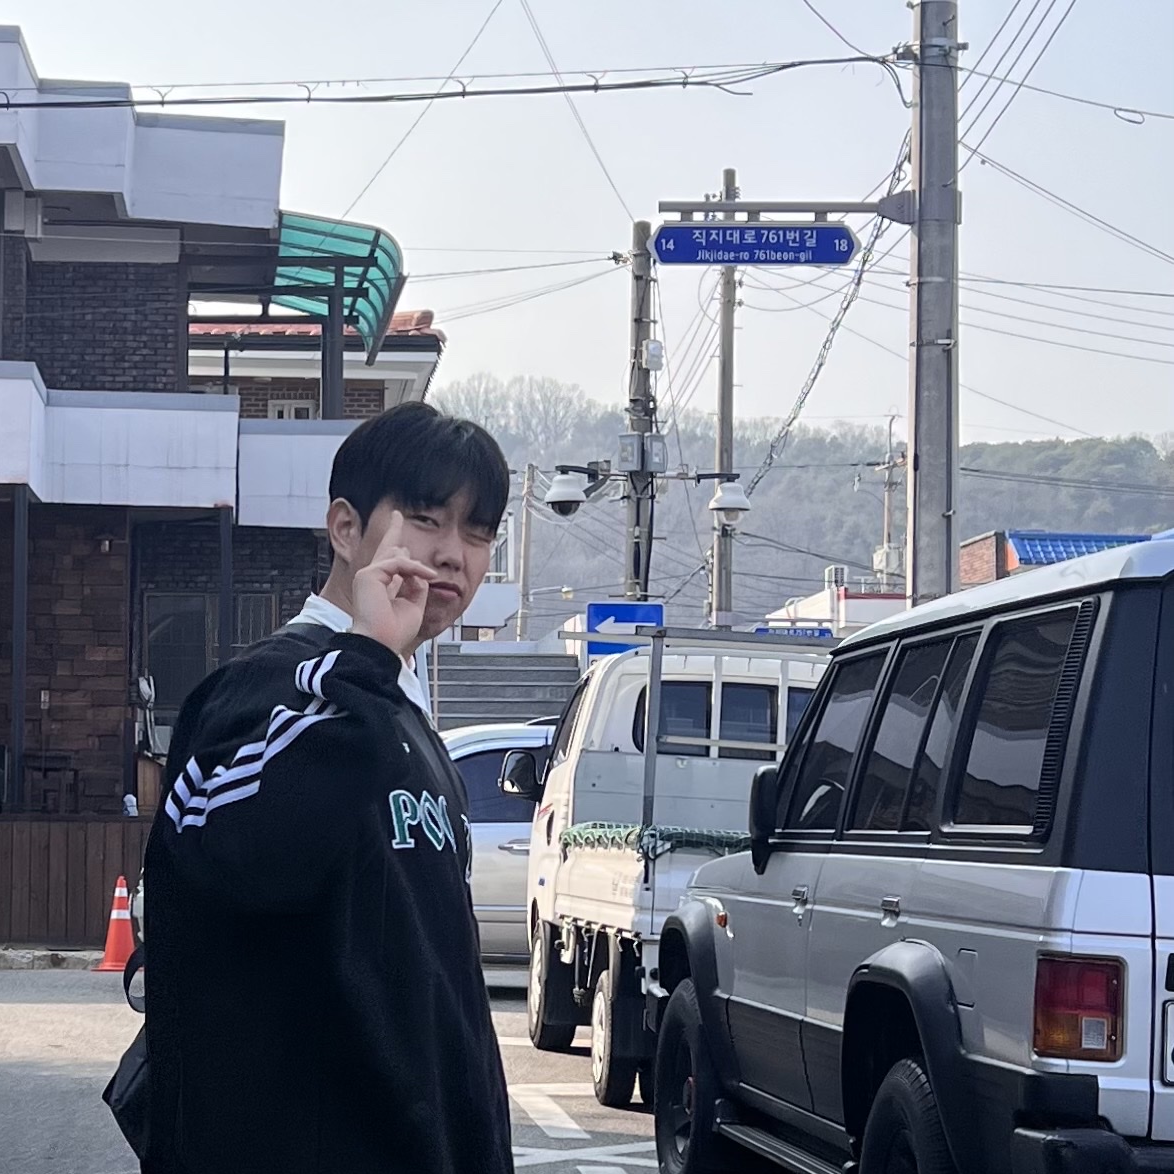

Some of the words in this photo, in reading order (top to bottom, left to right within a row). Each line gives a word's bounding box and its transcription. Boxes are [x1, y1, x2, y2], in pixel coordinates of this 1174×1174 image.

[660, 238, 675, 251] 14
[833, 238, 849, 252] 18
[696, 249, 750, 262] Jikjidae-ro
[753, 249, 813, 262] 761beon-gil
